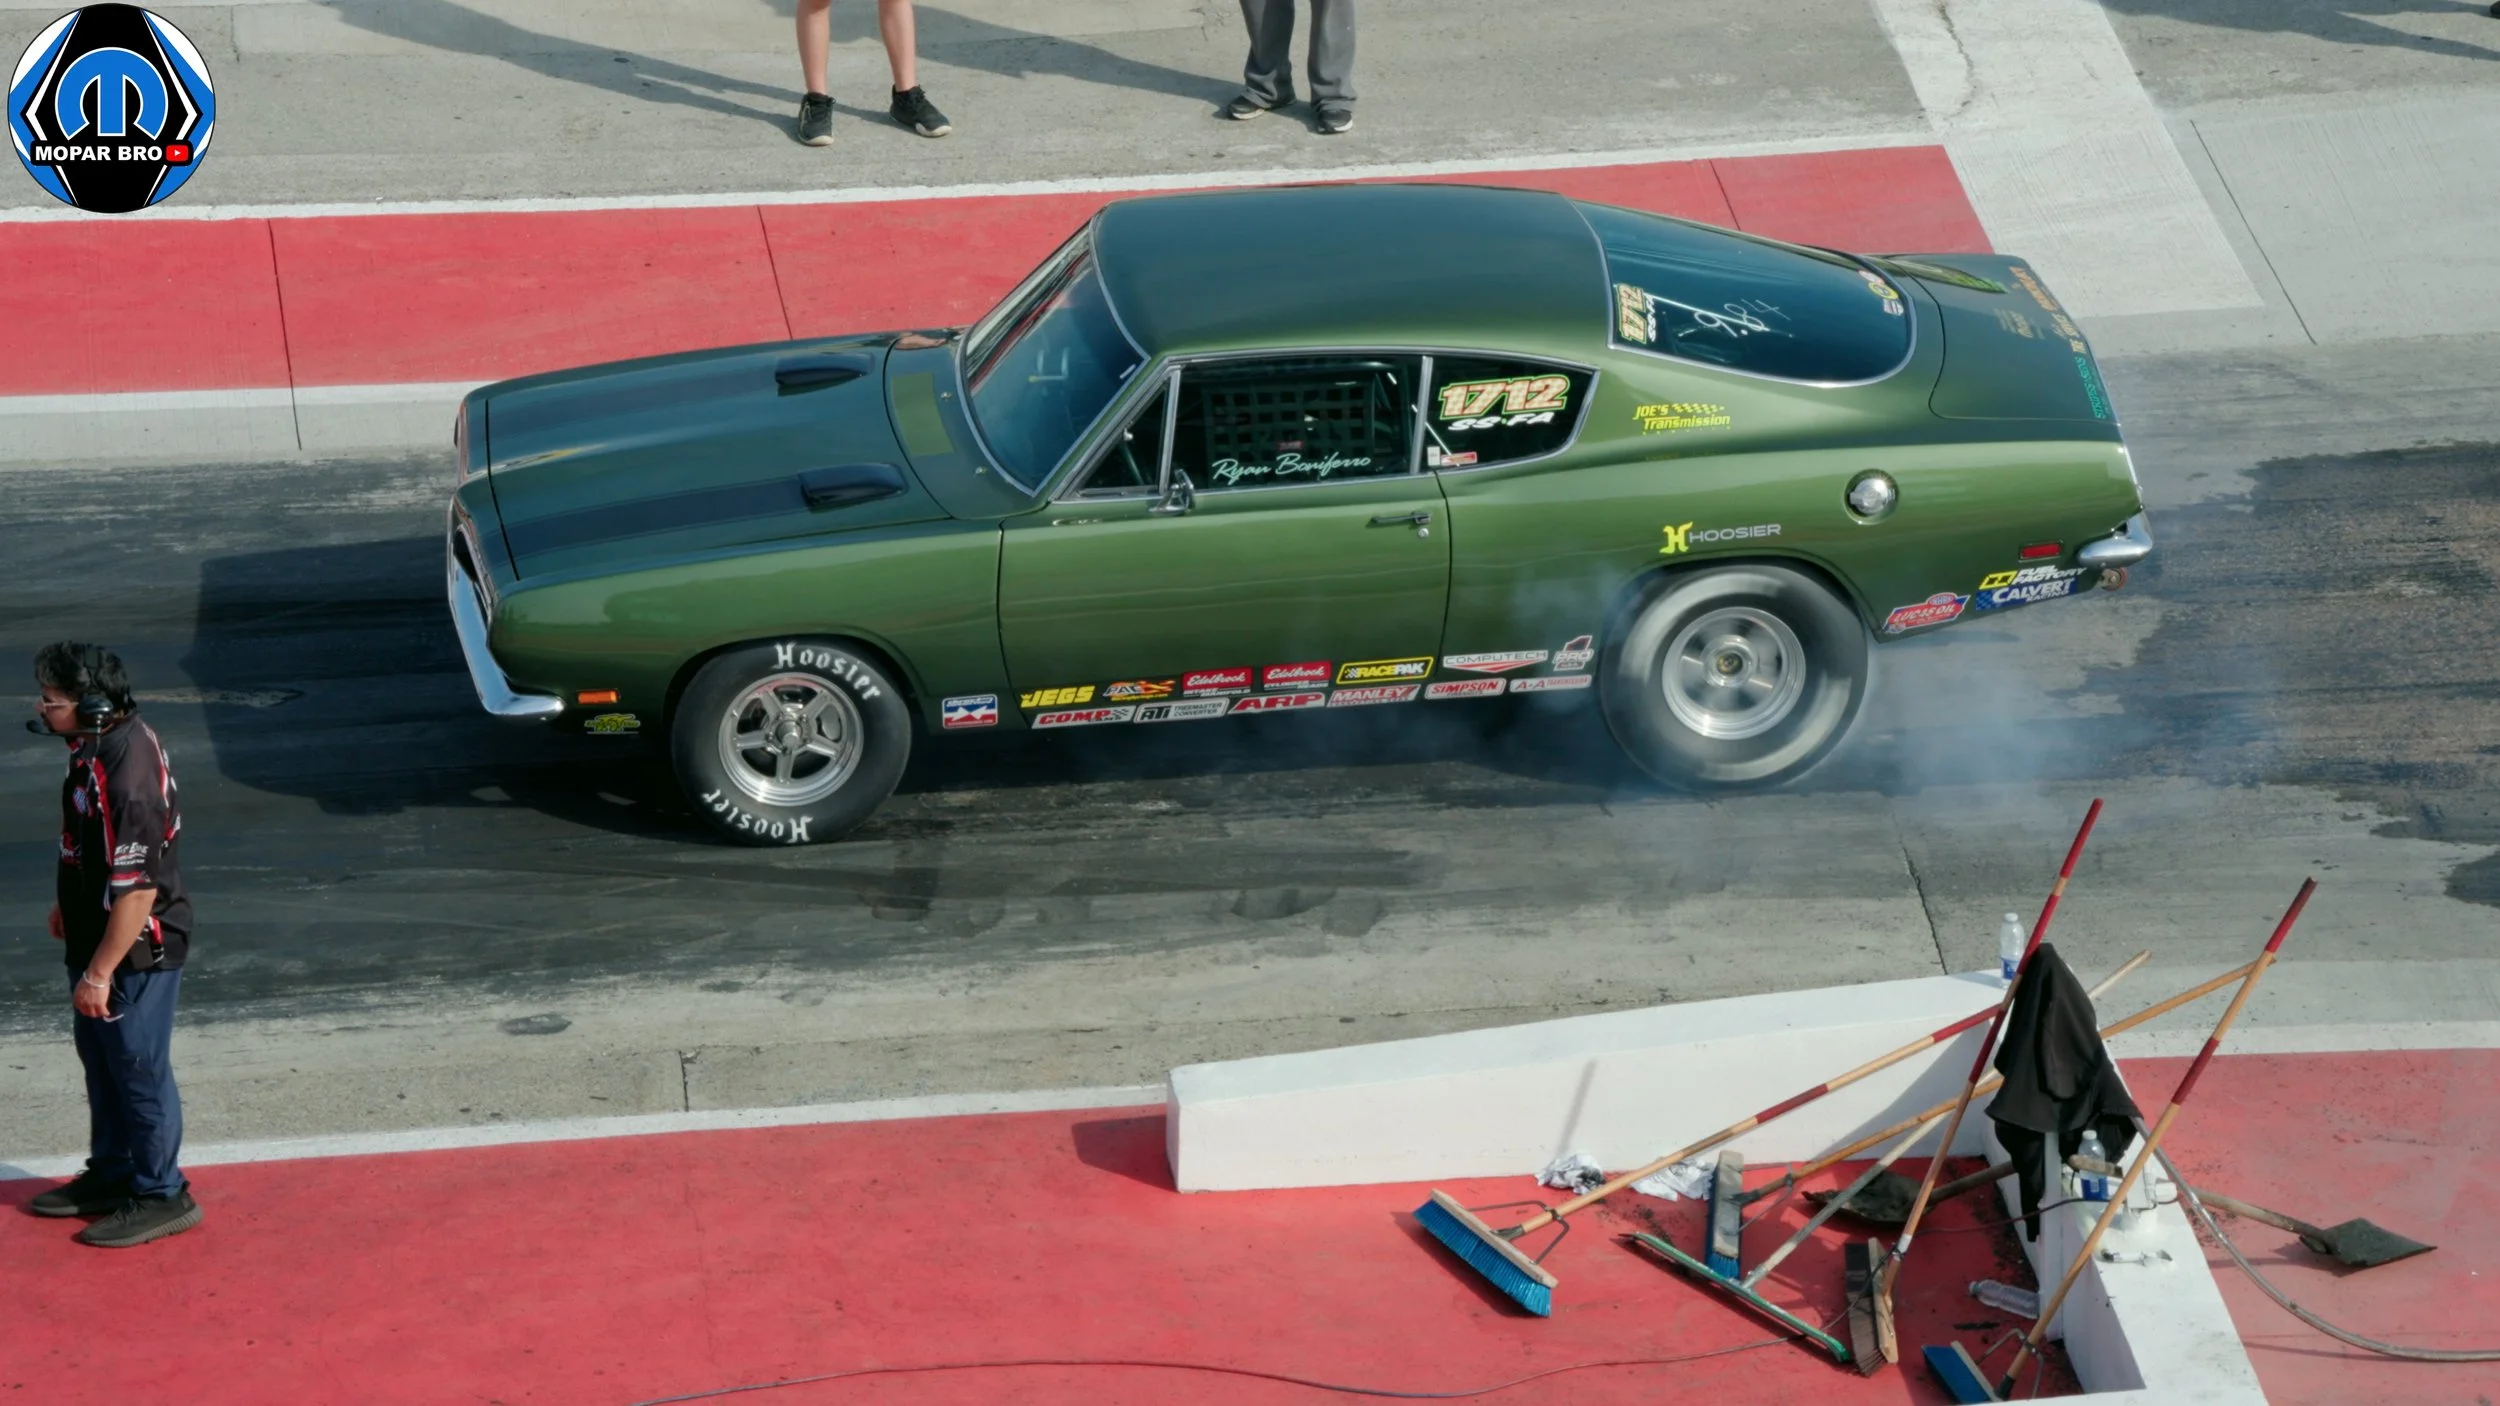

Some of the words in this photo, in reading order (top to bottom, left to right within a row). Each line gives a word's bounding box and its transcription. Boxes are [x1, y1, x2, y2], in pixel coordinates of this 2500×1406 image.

[1615, 283, 1647, 345] 1712
[1694, 298, 1792, 338] 9.84
[1439, 374, 1570, 420] 1712
[1632, 403, 1670, 420] JOE'S
[1643, 415, 1731, 431] Transmission
[1212, 458, 1271, 486] Ryan
[1275, 452, 1372, 477] Boniferro
[1689, 523, 1782, 544] HOOSIER
[2011, 567, 2088, 585] FACTORY
[2018, 564, 2058, 577] FUEL
[1992, 577, 2076, 603] CALVERT
[1894, 606, 1936, 622] LUCAS
[1935, 603, 1956, 615] OIL
[1445, 651, 1547, 665] COMPUTECH
[1552, 648, 1594, 664] PRO
[771, 641, 882, 700] Hoosier
[1267, 666, 1325, 680] Edelbrock
[1356, 662, 1426, 678] RACEPAK
[1187, 671, 1247, 687] Edelbrock
[1335, 686, 1406, 701] MANLEY
[1431, 681, 1498, 694] SIMPSON
[1021, 685, 1096, 708] JEGS
[1233, 693, 1323, 711] ARP
[1140, 705, 1172, 721] ATI
[1173, 708, 1218, 717] CONVERTER
[1174, 702, 1222, 712] TREEMASTER
[1039, 709, 1112, 725] COMP
[701, 788, 814, 844] Hoosier
